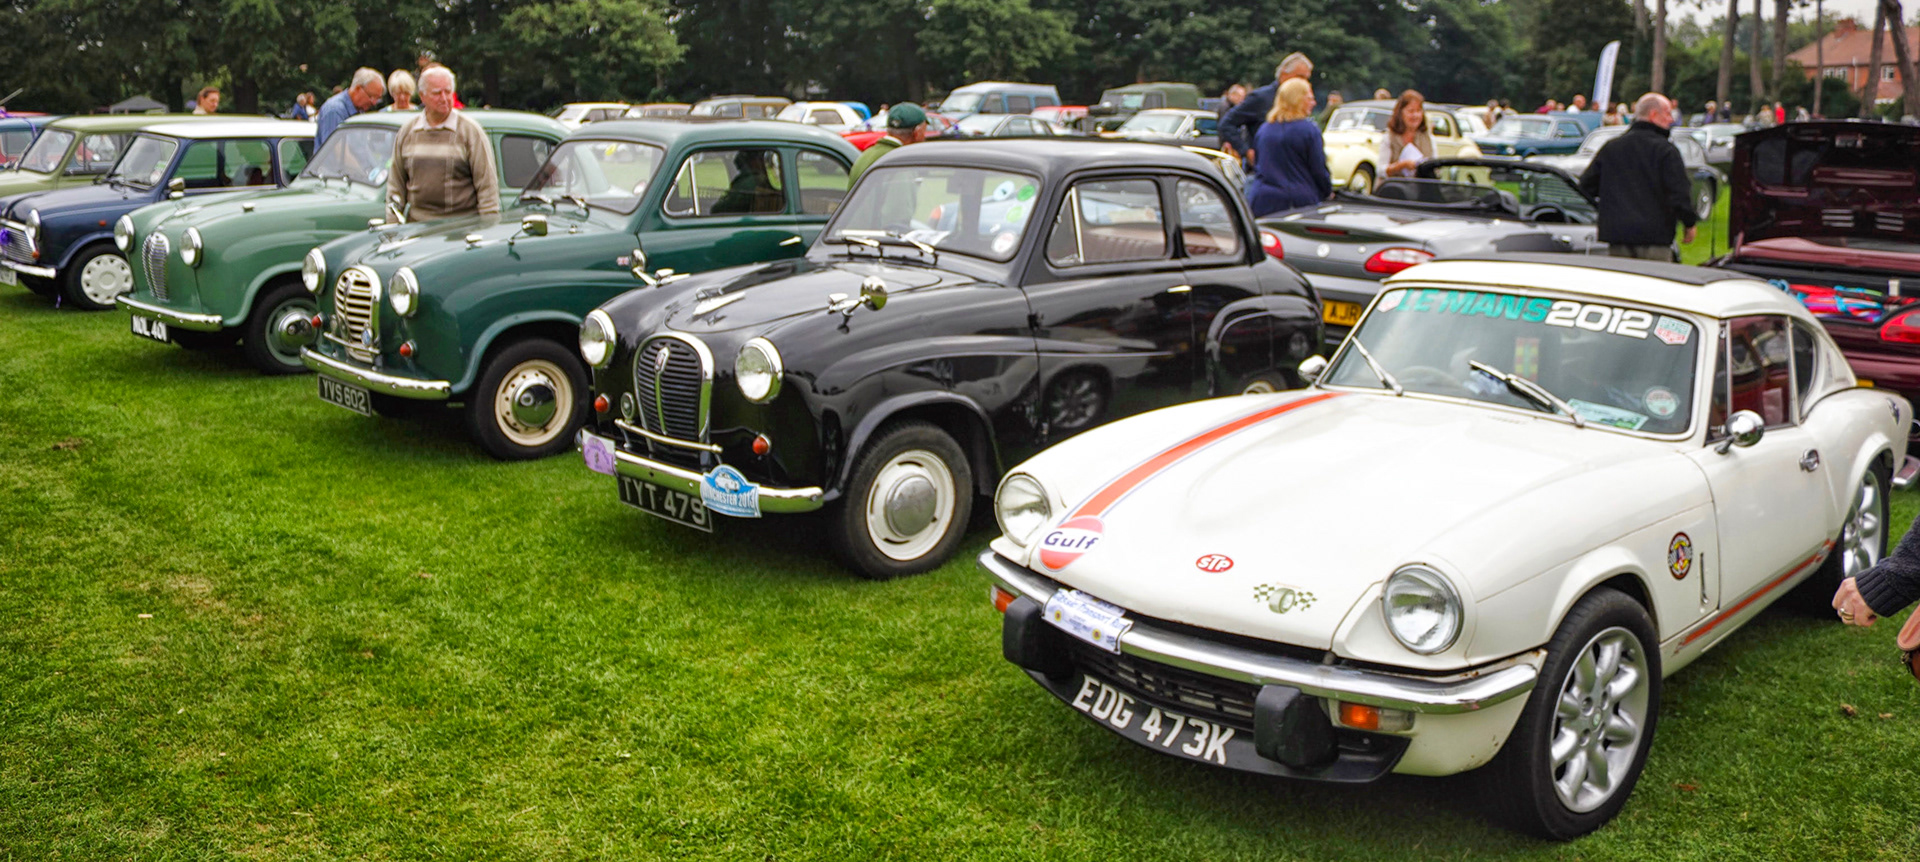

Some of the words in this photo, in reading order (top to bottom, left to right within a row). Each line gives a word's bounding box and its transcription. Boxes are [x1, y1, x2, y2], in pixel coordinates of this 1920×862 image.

[1329, 302, 1357, 321] AJR
[1396, 289, 1439, 312] LE
[1438, 290, 1552, 323] MANS
[1544, 300, 1653, 339] 2012
[322, 379, 343, 404] YVS
[343, 386, 366, 412] 602
[621, 476, 656, 510] TYT
[664, 489, 706, 525] 479
[738, 487, 756, 509] 2013
[1044, 531, 1099, 549] Gulf
[1198, 555, 1230, 571] STP
[1072, 674, 1134, 729] EDG
[1141, 707, 1235, 765] 473K
